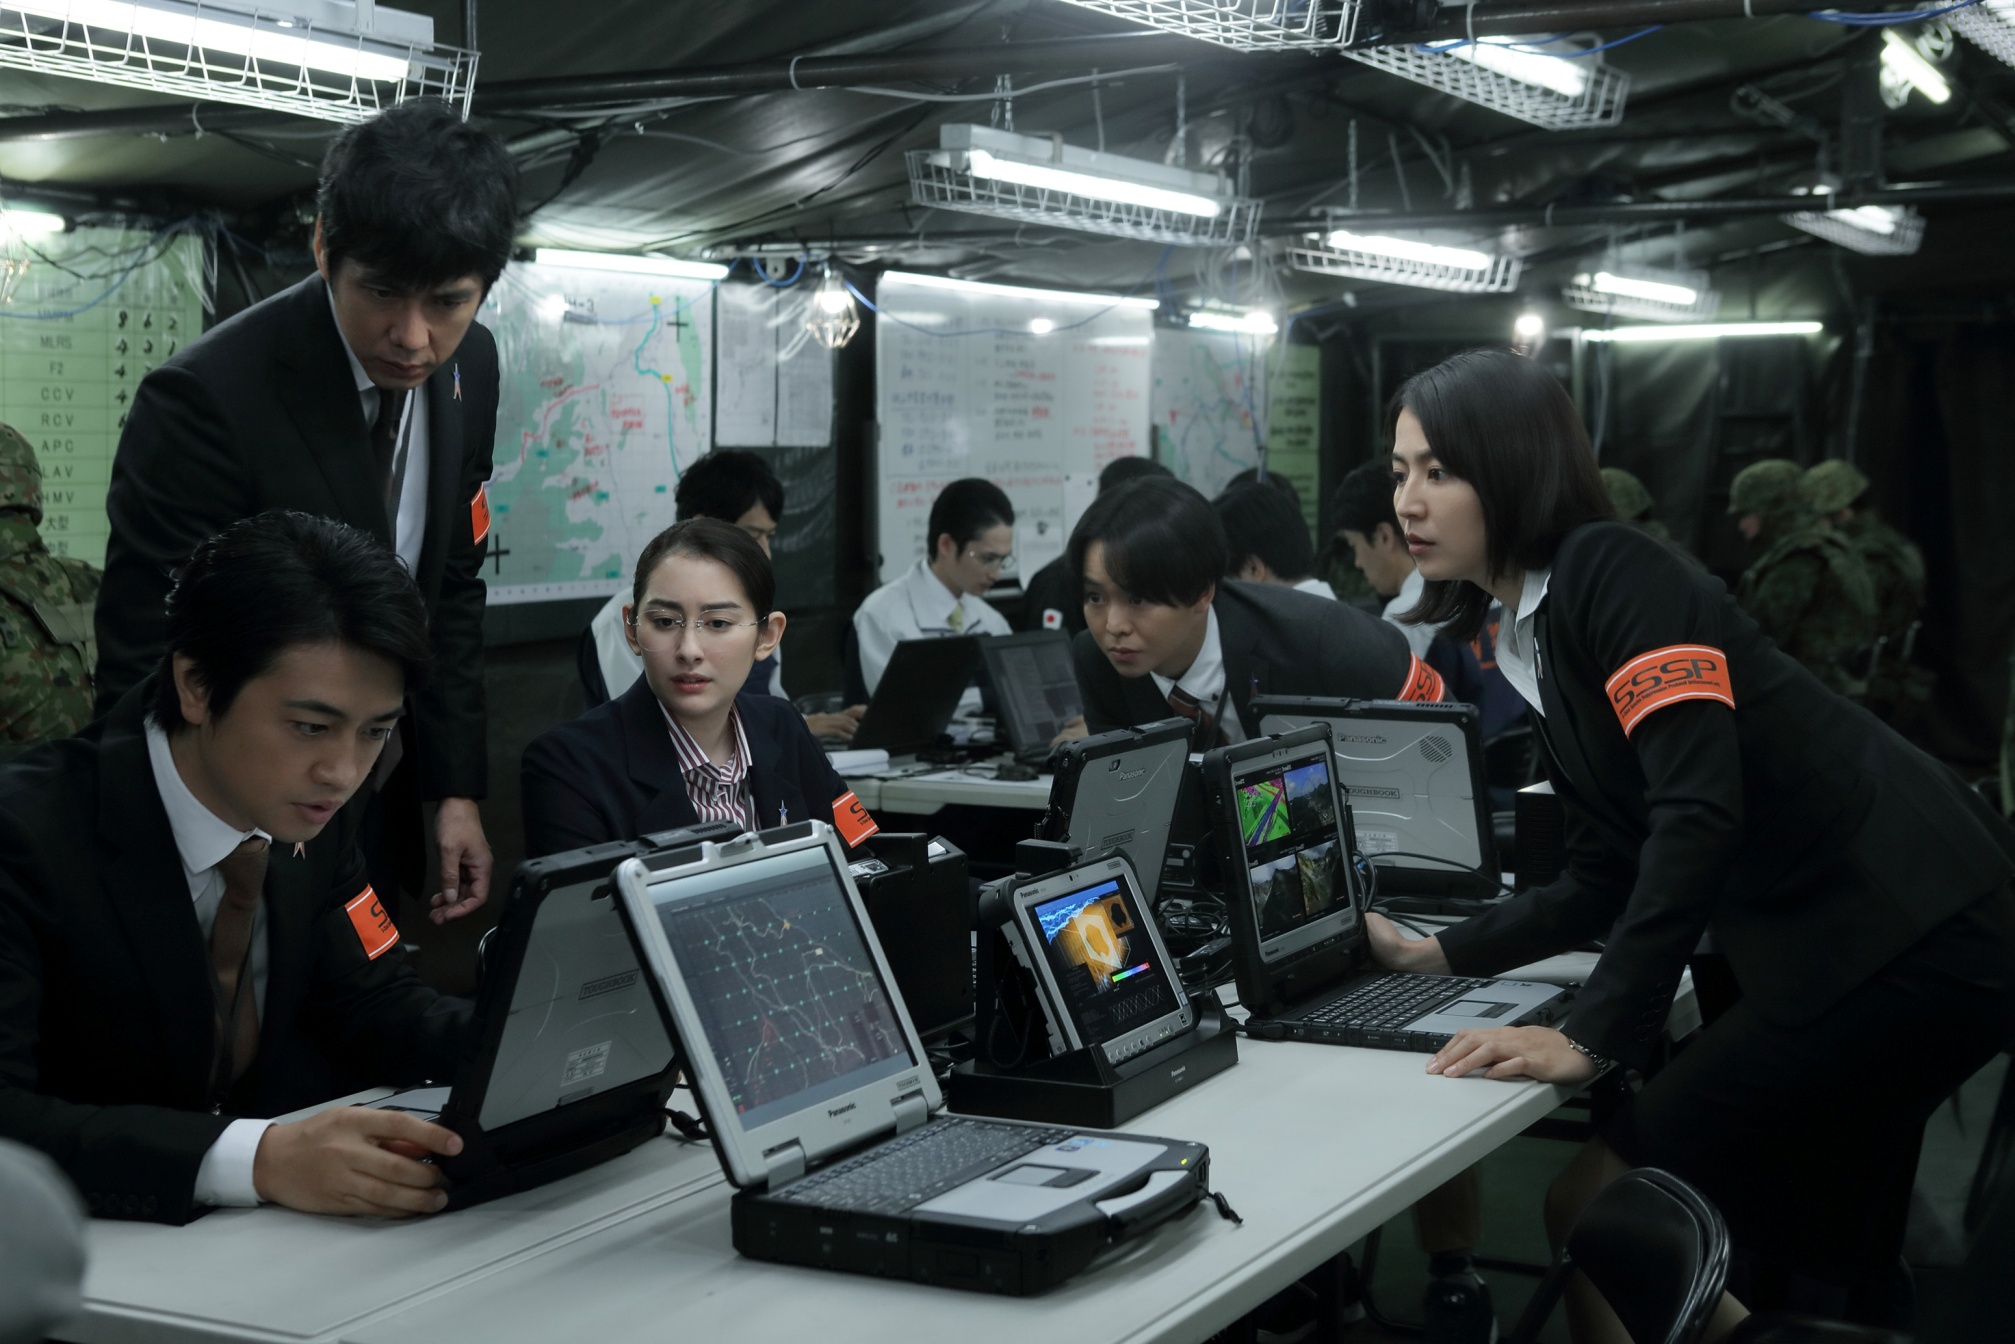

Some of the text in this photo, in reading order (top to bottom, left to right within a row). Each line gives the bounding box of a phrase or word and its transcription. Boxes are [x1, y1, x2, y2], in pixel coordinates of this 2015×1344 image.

[40, 335, 72, 349] MLRS
[45, 516, 69, 531] 大型
[1614, 659, 1717, 714] SSSP
[1337, 733, 1387, 744] Panasonic
[1120, 768, 1145, 781] Panasonic
[1346, 788, 1398, 798] OUGHBOOK
